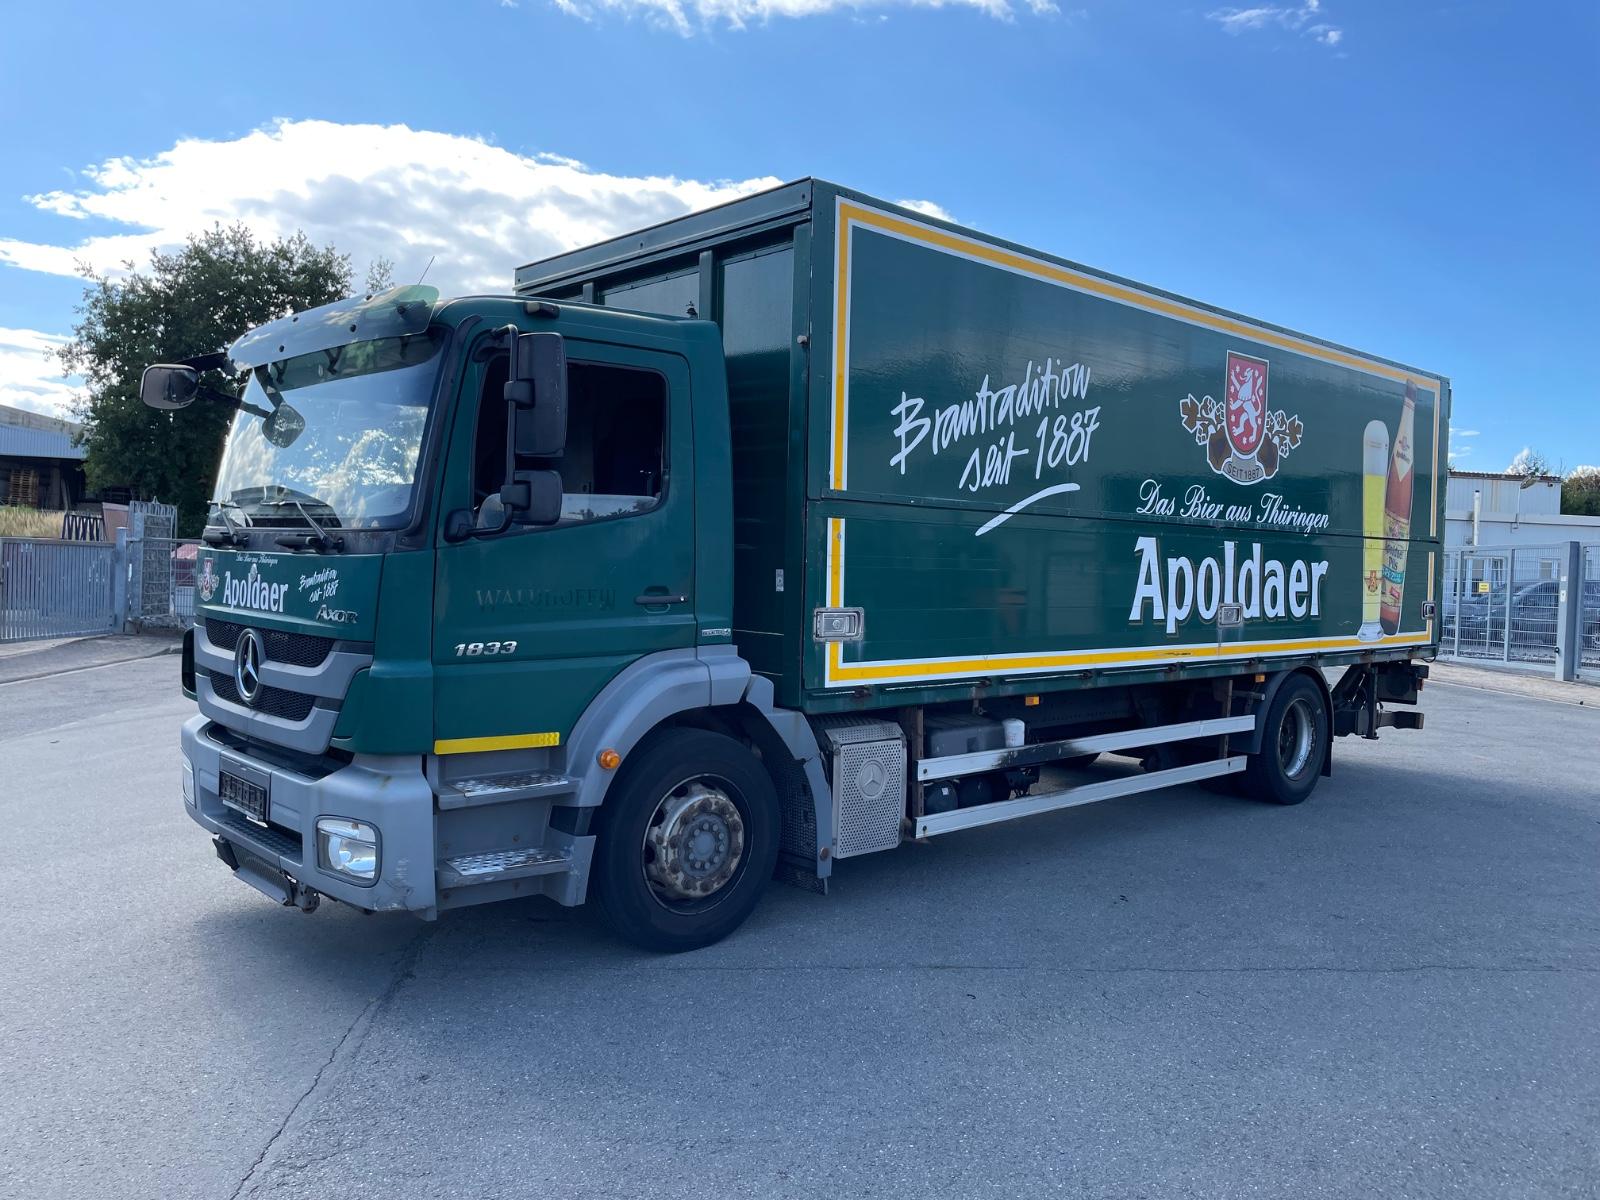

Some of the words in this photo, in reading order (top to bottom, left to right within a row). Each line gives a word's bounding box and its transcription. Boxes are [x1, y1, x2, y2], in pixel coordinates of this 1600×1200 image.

[890, 357, 1091, 475] Brautradition
[958, 431, 1029, 492] seit
[1035, 405, 1102, 480] 1887
[1227, 463, 1244, 480] SEIT
[1136, 479, 1176, 516] Das
[1180, 484, 1224, 520] Bier
[1225, 504, 1252, 523] aus
[1256, 493, 1330, 537] Thüringen
[222, 569, 290, 613] Apoldaer
[1128, 536, 1331, 635] Apoldaer
[453, 640, 519, 658] 1833
